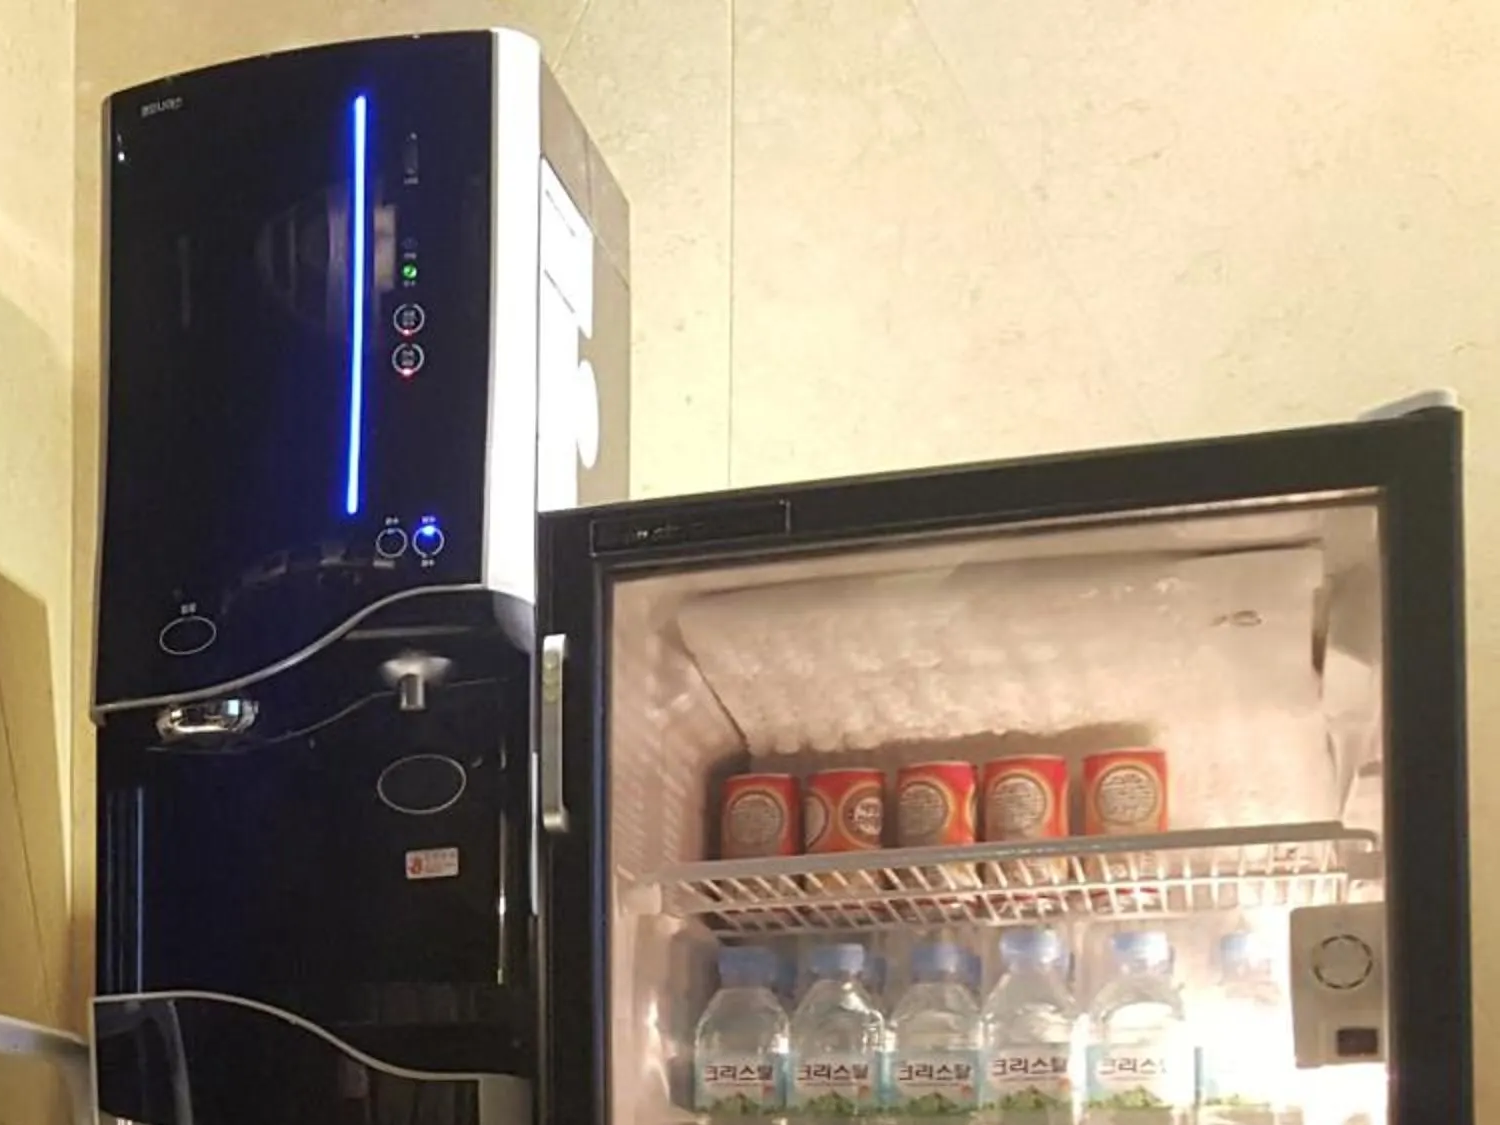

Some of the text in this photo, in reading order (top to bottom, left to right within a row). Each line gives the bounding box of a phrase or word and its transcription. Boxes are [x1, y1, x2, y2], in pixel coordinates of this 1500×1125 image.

[899, 1062, 971, 1081] 크리스탈
[993, 1056, 1068, 1077] 크리스탈
[1099, 1056, 1168, 1075] 크리스
